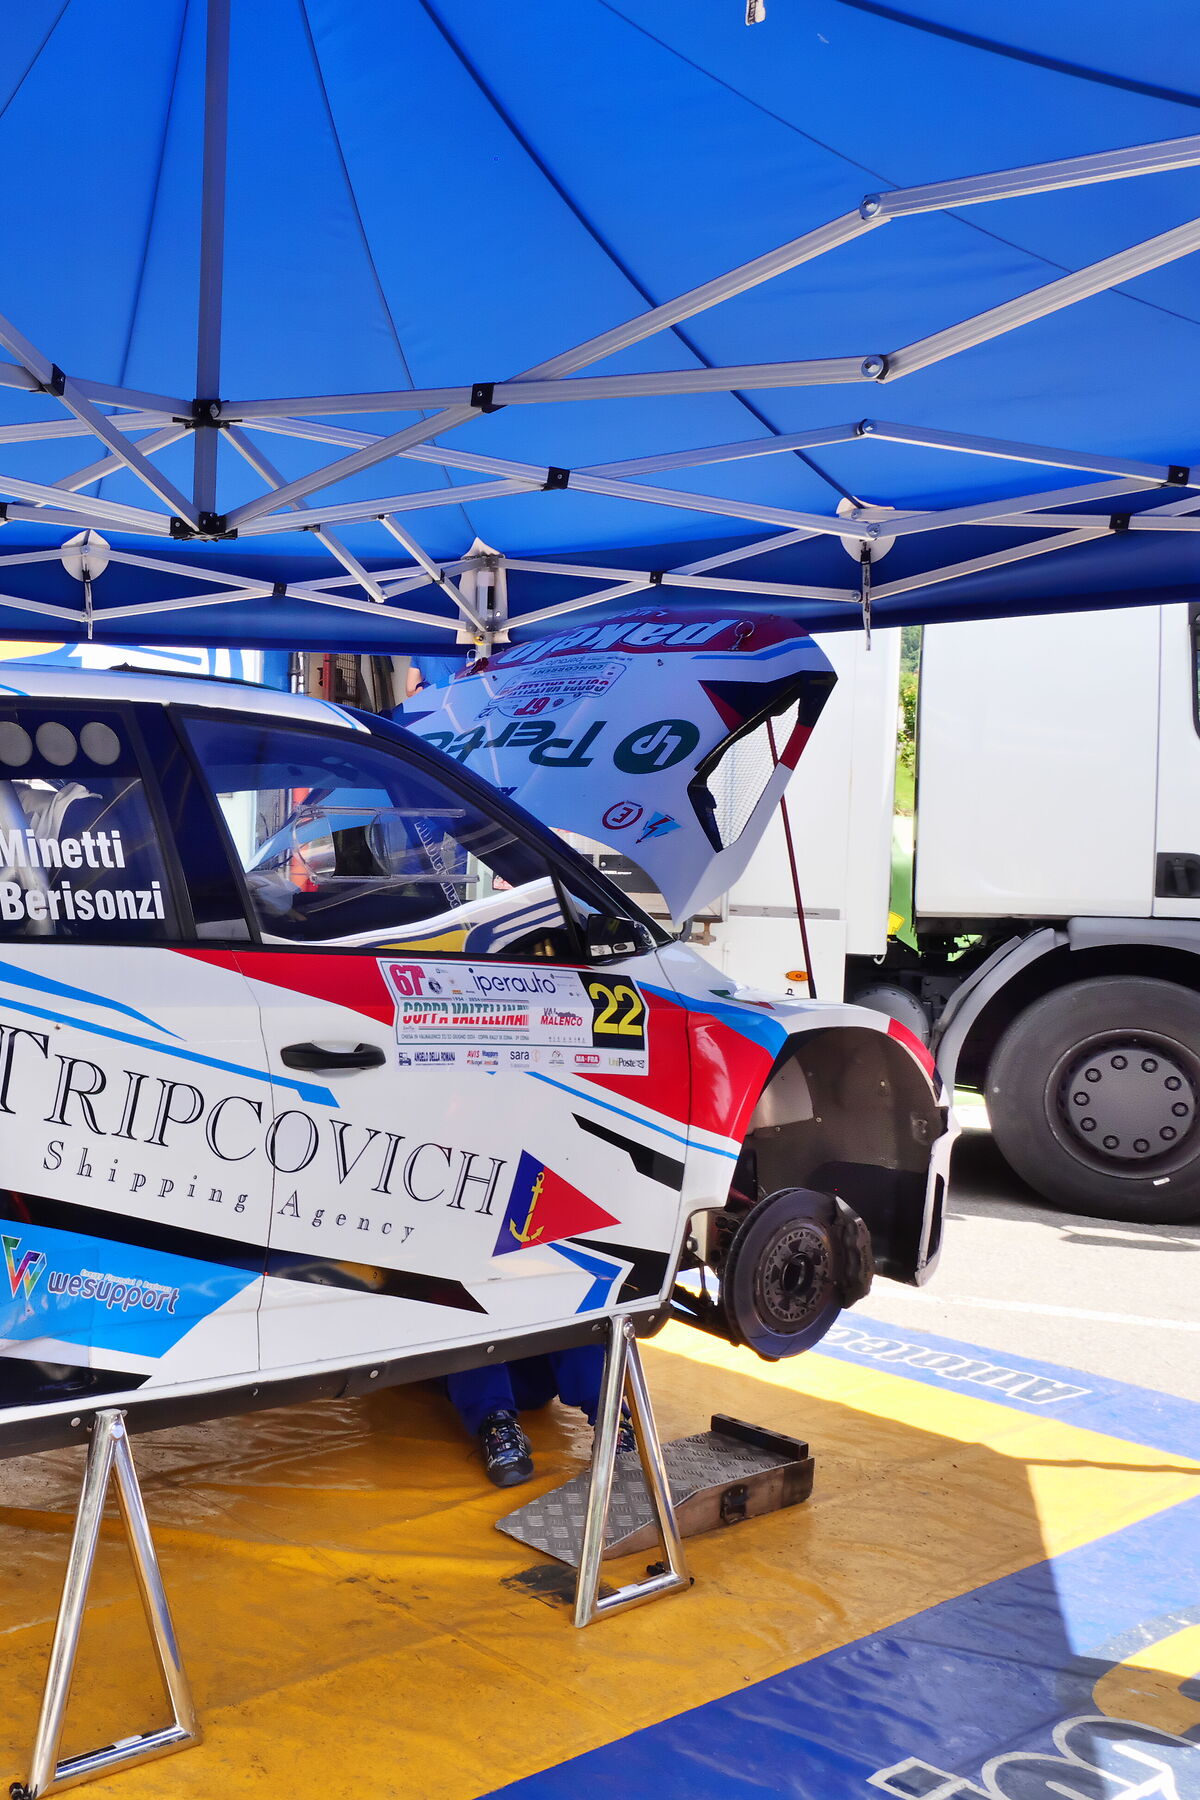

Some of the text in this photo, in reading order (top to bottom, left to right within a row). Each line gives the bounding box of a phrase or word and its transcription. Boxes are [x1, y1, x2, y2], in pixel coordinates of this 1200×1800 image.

[612, 807, 633, 824] E
[468, 967, 557, 997] iperauto
[541, 1015, 583, 1027] MALENCO
[588, 982, 643, 1037] 22
[510, 1050, 530, 1060] sara
[42, 1140, 416, 1244] Shipping Agency
[48, 1271, 180, 1315] wesupport
